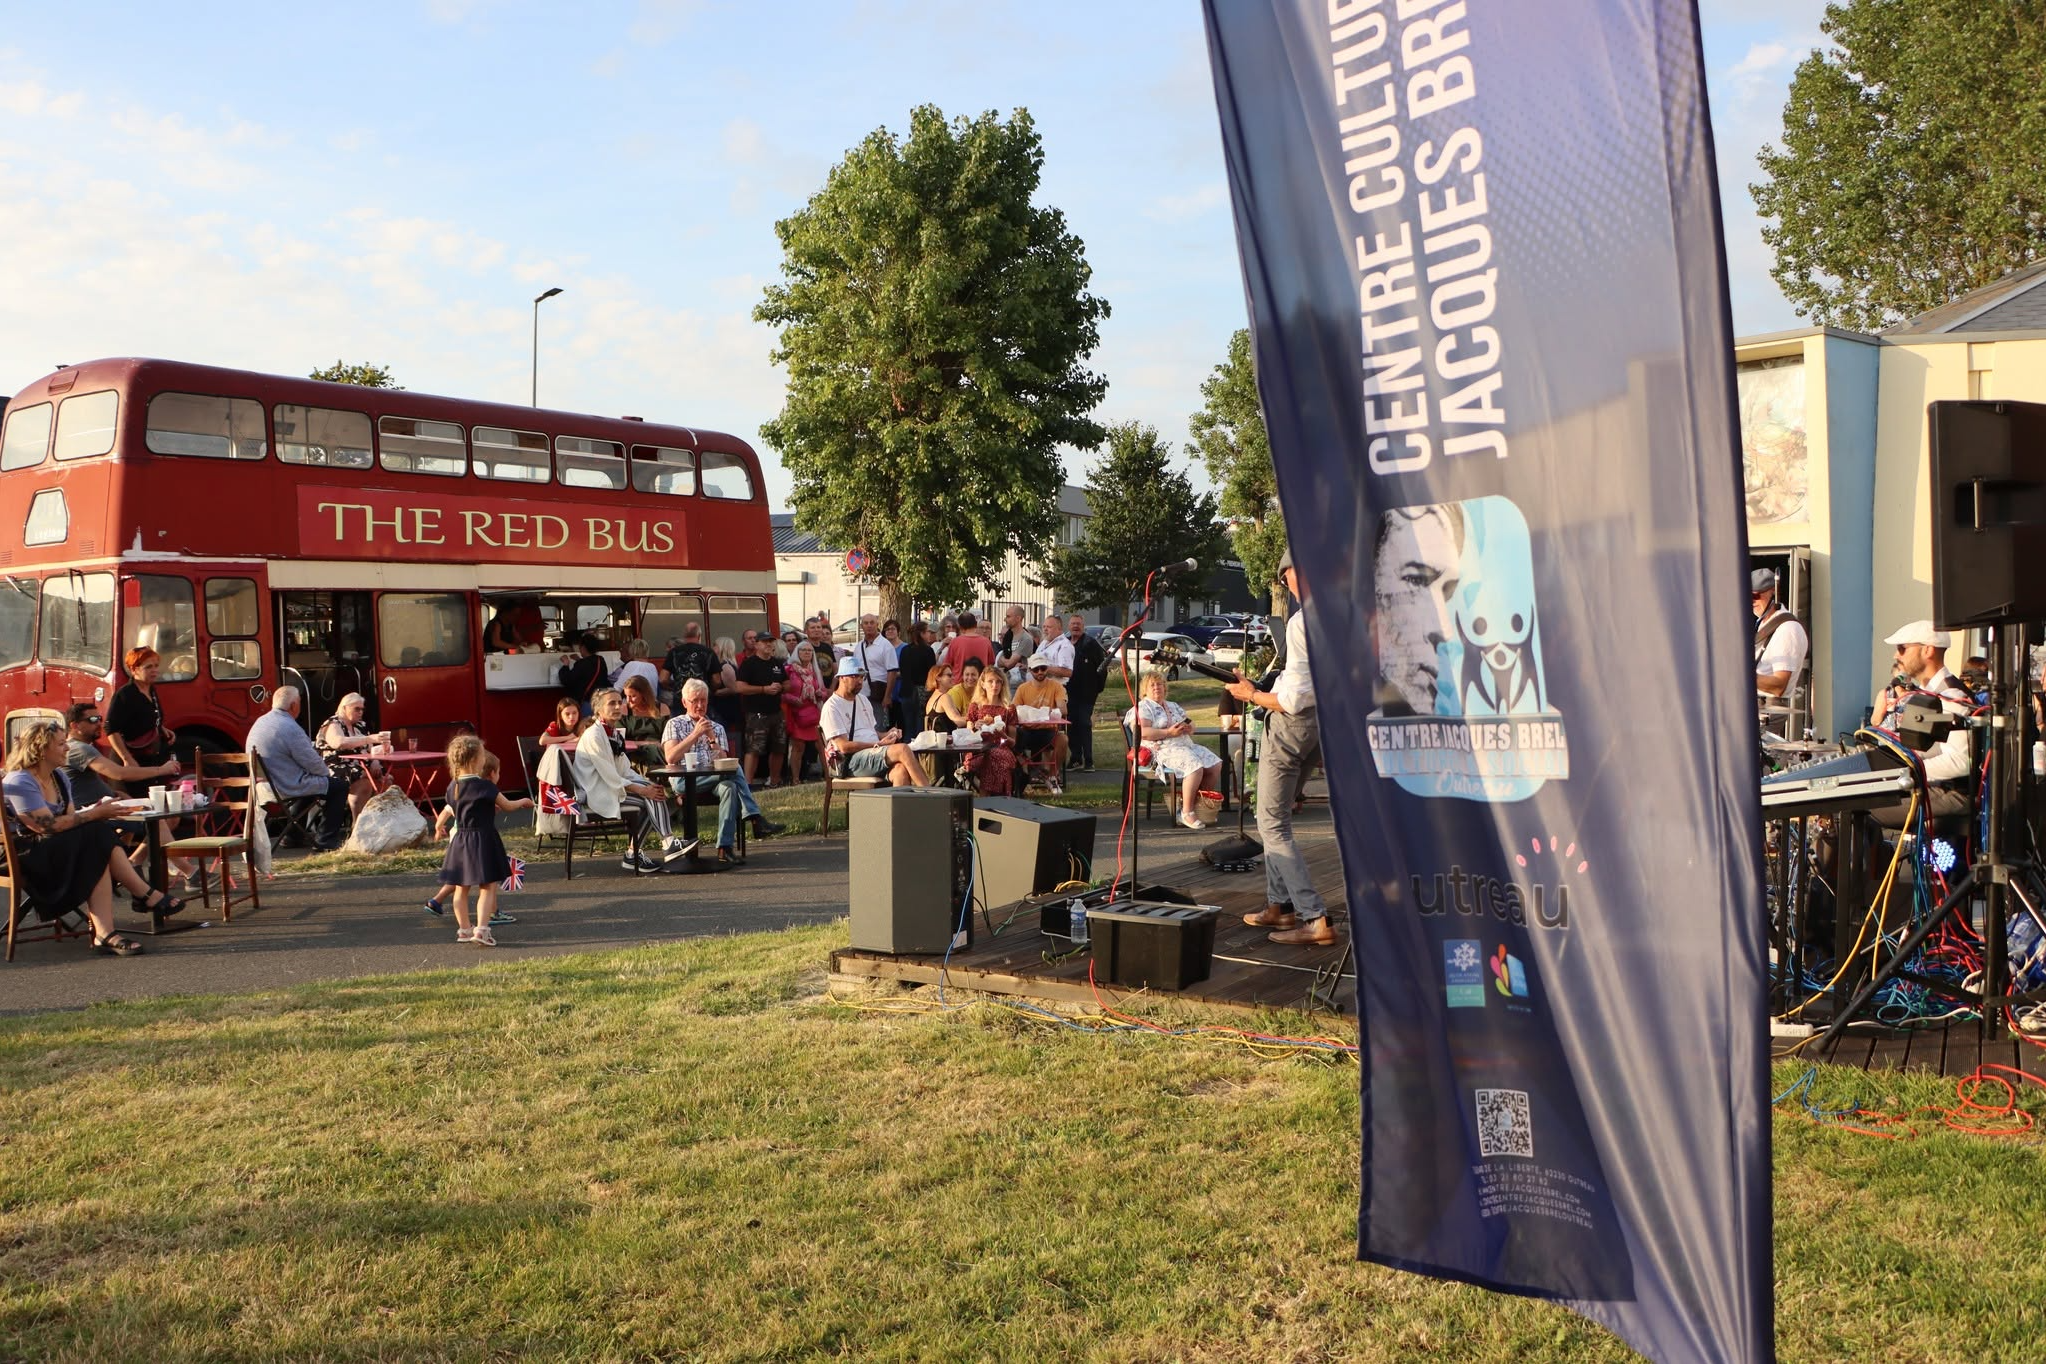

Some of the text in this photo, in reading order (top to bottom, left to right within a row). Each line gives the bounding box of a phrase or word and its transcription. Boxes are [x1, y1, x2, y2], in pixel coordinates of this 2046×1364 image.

[1356, 221, 1432, 476] CENTRE
[1414, 127, 1508, 458] JACQUES
[318, 502, 674, 553] THE RED BUS
[1367, 723, 1441, 750] CENTRE
[1517, 722, 1566, 750] BREL
